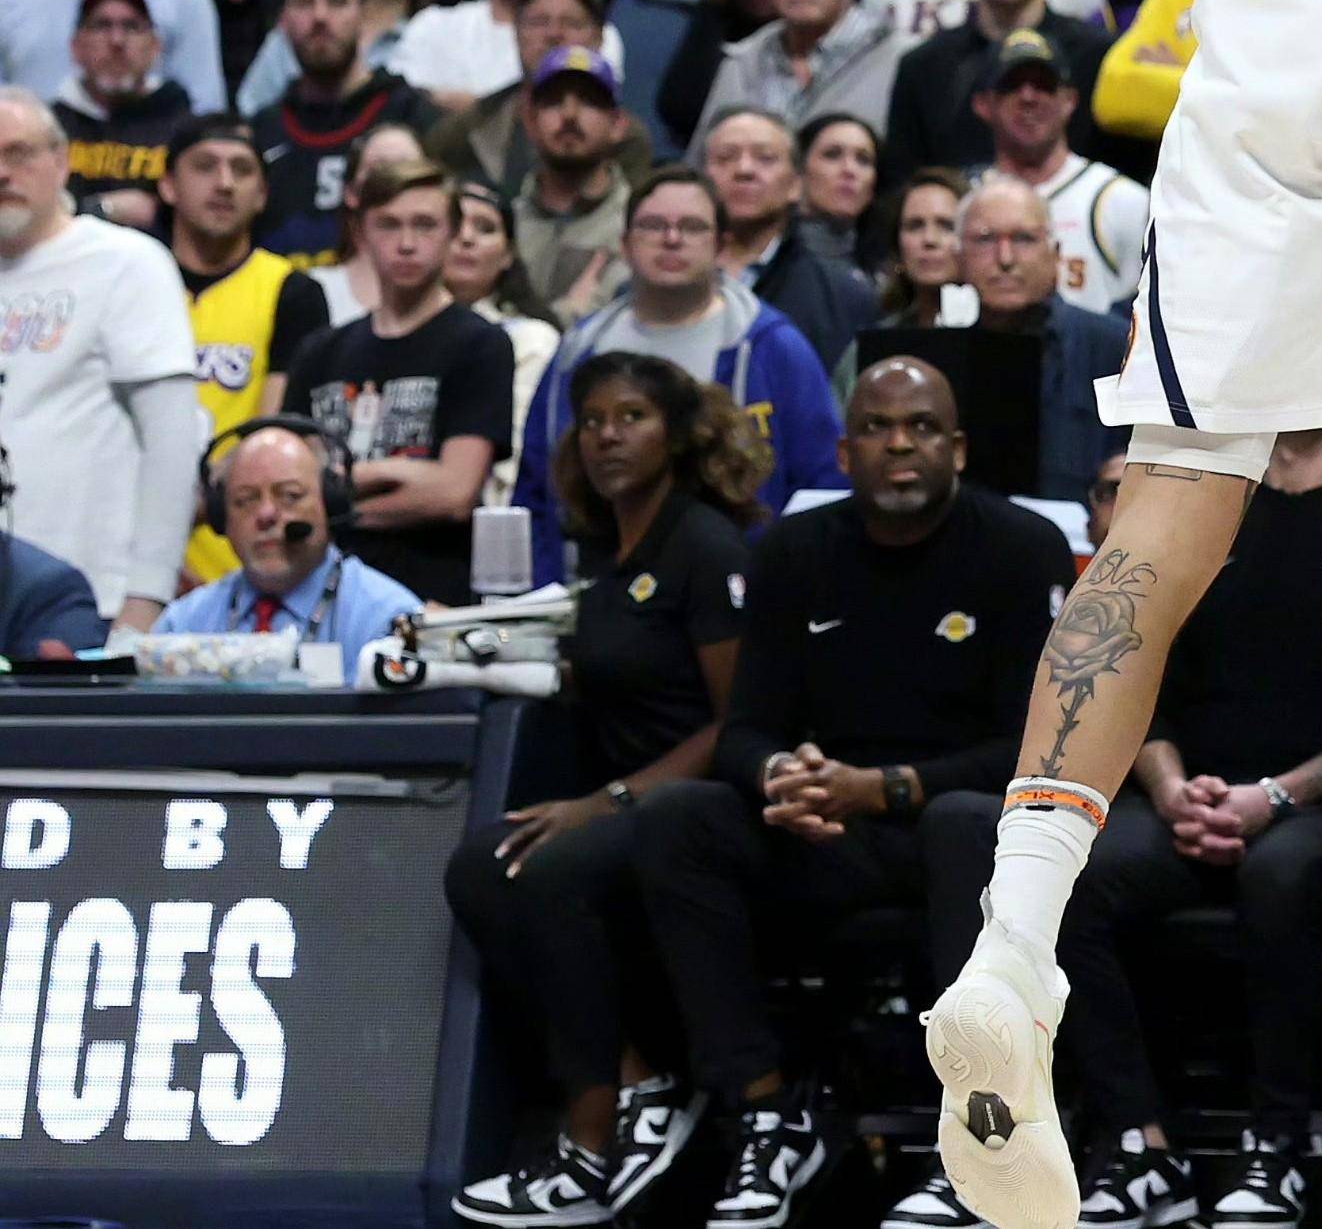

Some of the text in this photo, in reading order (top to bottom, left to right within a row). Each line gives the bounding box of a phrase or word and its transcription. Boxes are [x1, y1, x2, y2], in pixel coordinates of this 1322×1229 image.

[315, 155, 347, 210] 5
[161, 799, 335, 869] BY
[0, 898, 297, 1146] ICES
